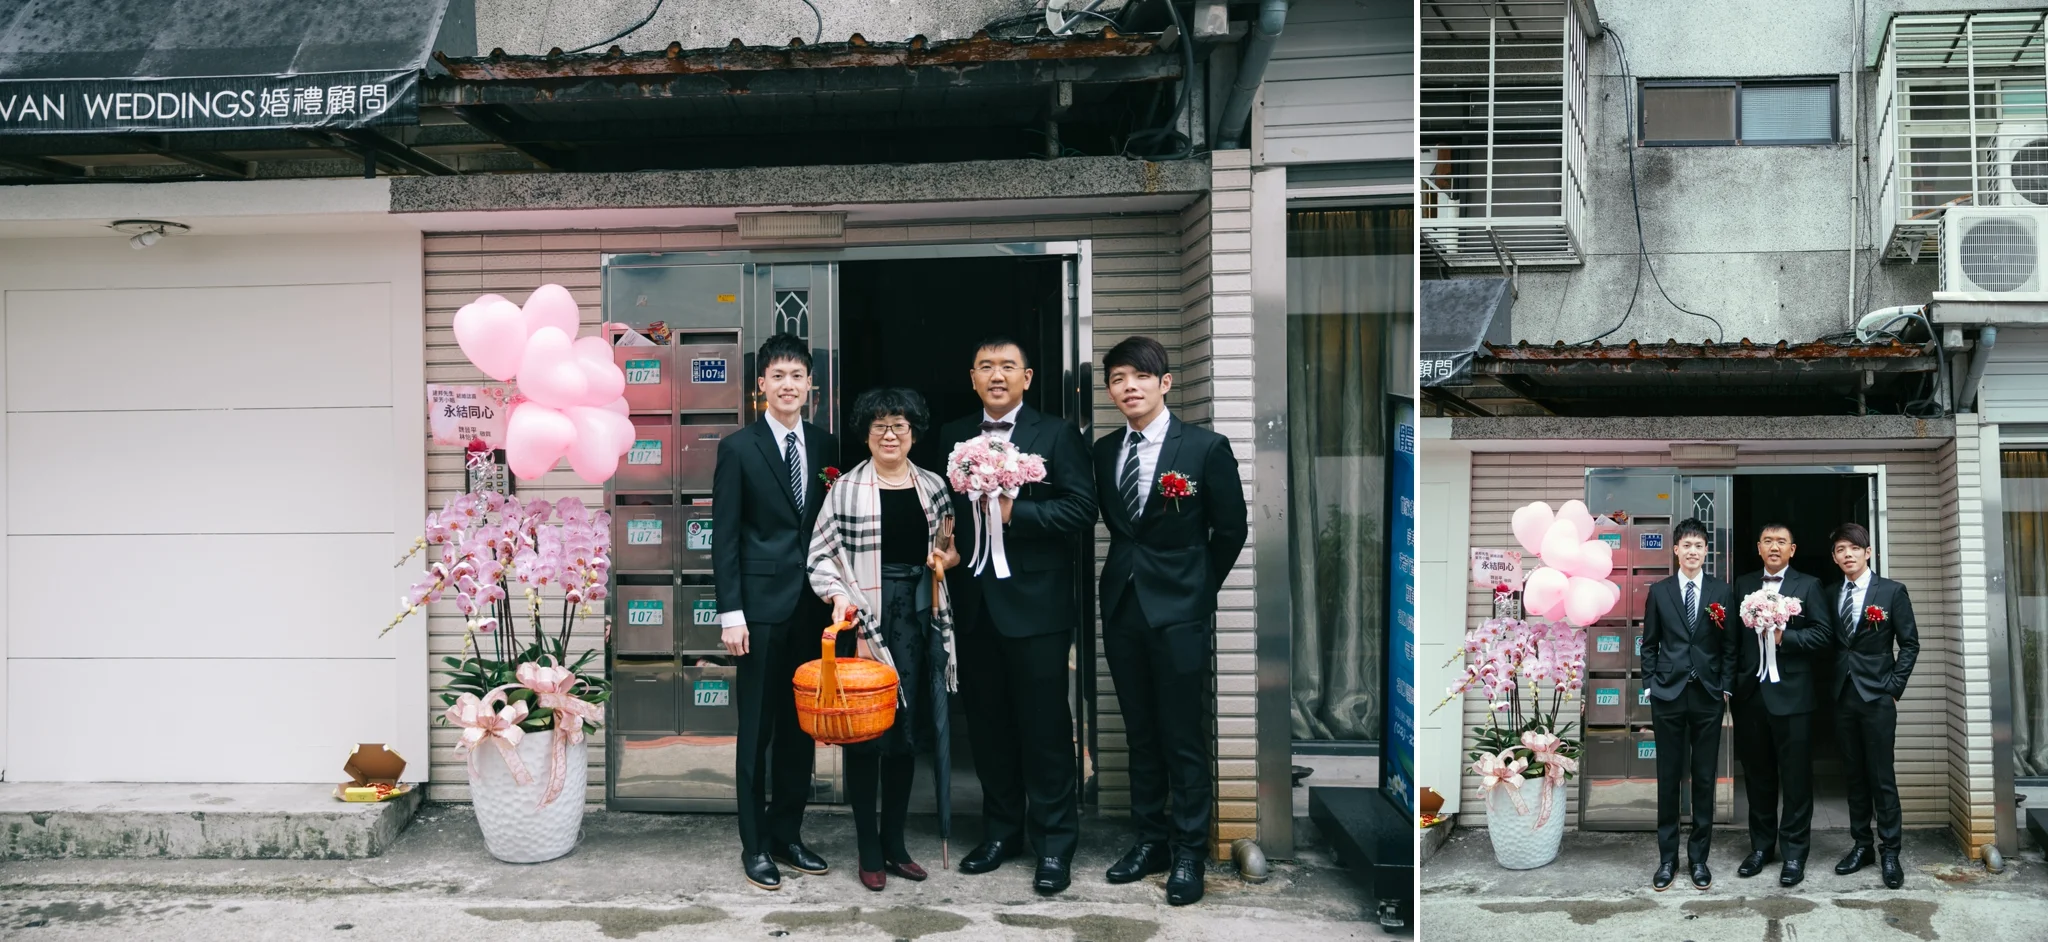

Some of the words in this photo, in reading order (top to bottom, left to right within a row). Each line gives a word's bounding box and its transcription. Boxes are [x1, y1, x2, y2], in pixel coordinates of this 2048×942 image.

[0, 93, 65, 122] VAN
[83, 90, 255, 119] WEDDINGS
[259, 84, 388, 117] 婚禮顧問
[628, 370, 650, 382] 107
[701, 369, 718, 379] 107
[444, 405, 494, 419] 永結同心
[629, 450, 652, 462] 107
[629, 531, 652, 543] 107
[1482, 561, 1514, 571] 永結同心
[630, 611, 653, 623] 107
[695, 611, 717, 623] 107
[696, 691, 719, 704] 107
[1597, 695, 1612, 704] 107
[1640, 748, 1654, 757] 107
